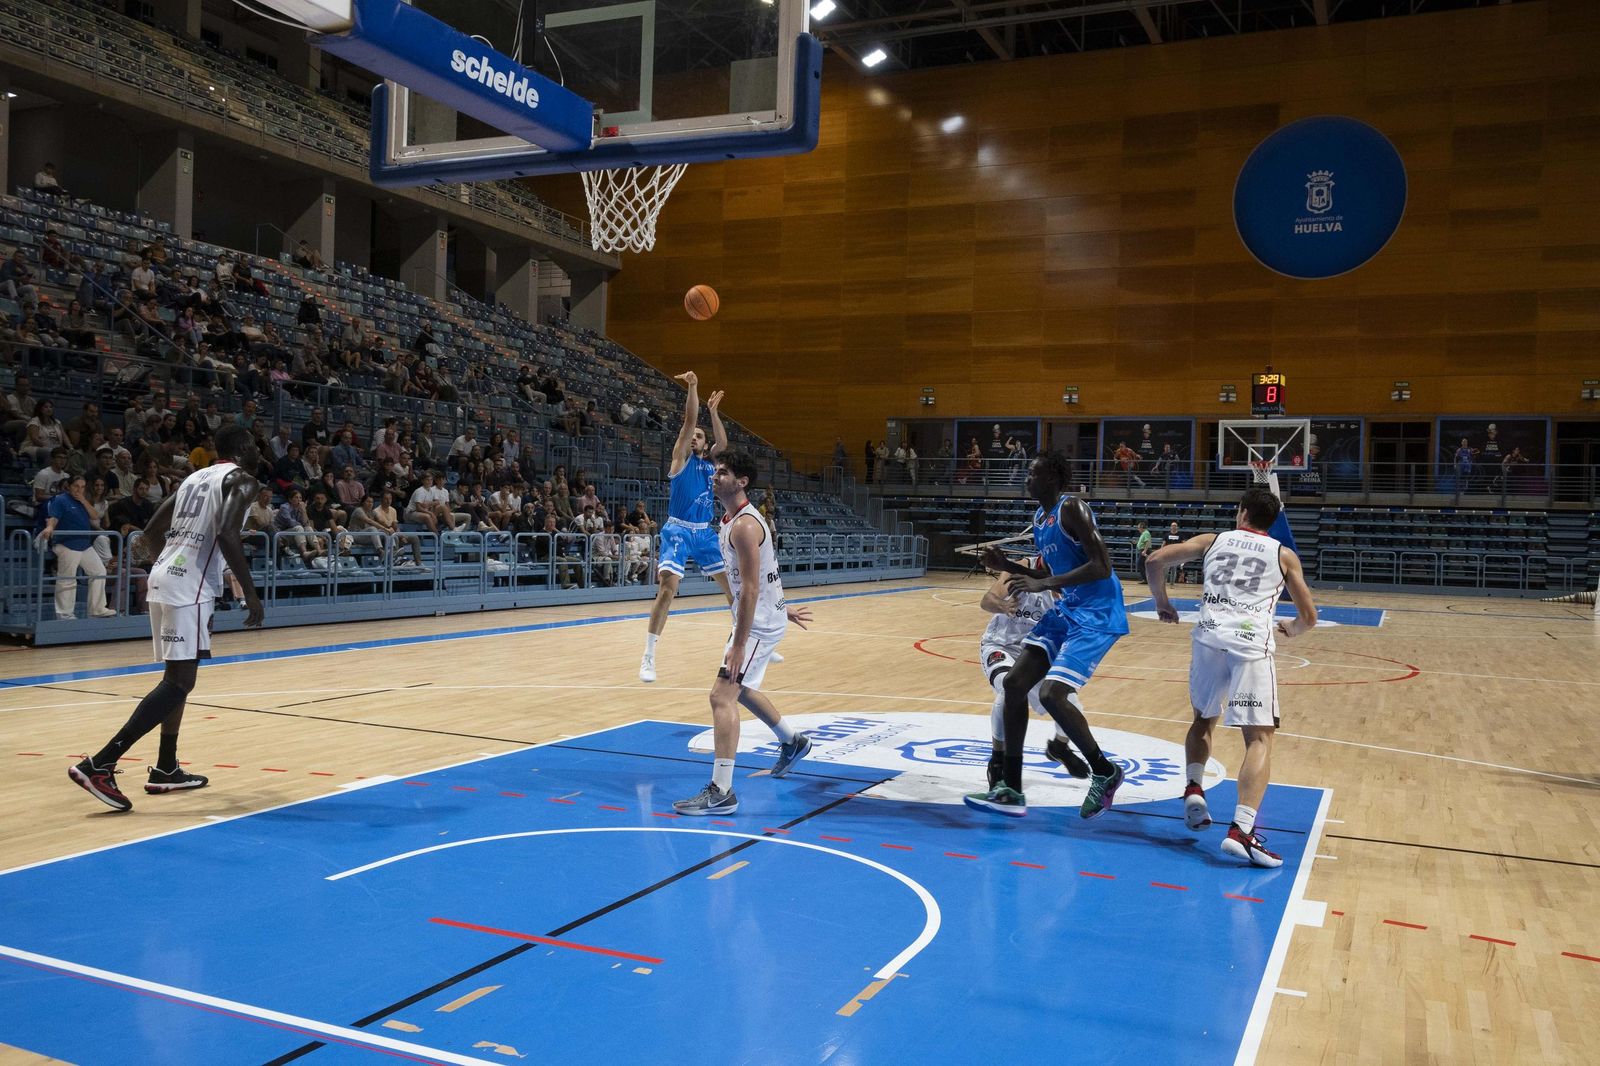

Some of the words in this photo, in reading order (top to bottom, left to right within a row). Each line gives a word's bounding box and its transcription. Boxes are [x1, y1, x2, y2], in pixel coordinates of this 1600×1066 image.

[451, 50, 539, 109] schelde
[1294, 223, 1343, 234] HUELVA
[1259, 374, 1279, 384] 3:29
[1267, 386, 1277, 403] 8
[177, 482, 210, 518] 16
[1211, 552, 1267, 592] 33
